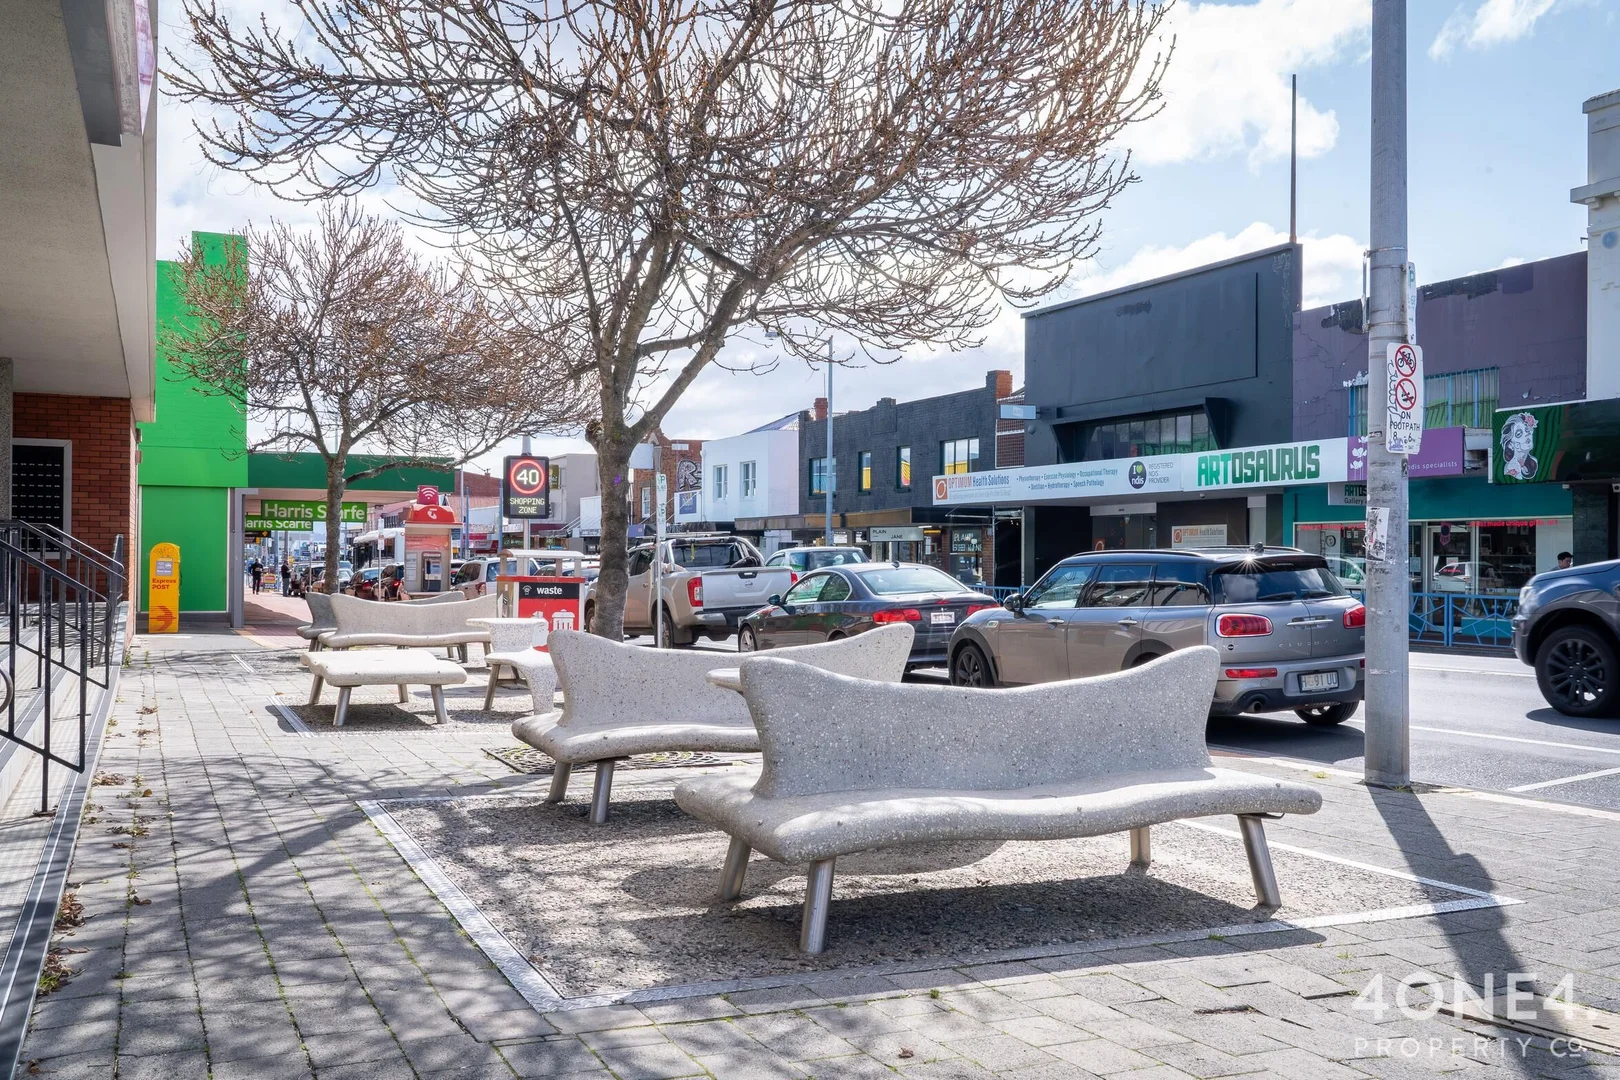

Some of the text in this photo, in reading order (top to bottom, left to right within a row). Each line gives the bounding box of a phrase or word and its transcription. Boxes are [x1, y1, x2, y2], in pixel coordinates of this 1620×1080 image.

[1402, 411, 1410, 419] ON
[1389, 421, 1420, 431] FOOTPATH
[1148, 461, 1174, 470] REGISTERED
[1197, 444, 1320, 487] ARTOSAURUS
[1422, 461, 1458, 470] specialists
[516, 469, 539, 485] 40
[1018, 475, 1040, 483] Physiotherapy
[1058, 471, 1077, 480] Physiology
[1103, 468, 1118, 476] Therapy
[1148, 476, 1170, 484] PROVIDER
[948, 473, 1009, 489] OPTIMUM Health Solutions
[1073, 480, 1086, 488] Speech
[1086, 479, 1104, 487] Pathology
[1131, 476, 1144, 485] ndis
[510, 497, 545, 506] SHOPPING
[264, 503, 365, 520] Harris Srfe
[518, 506, 537, 514] ZONE
[245, 518, 273, 529] arris
[1506, 520, 1529, 528] unique
[536, 586, 563, 595] waste
